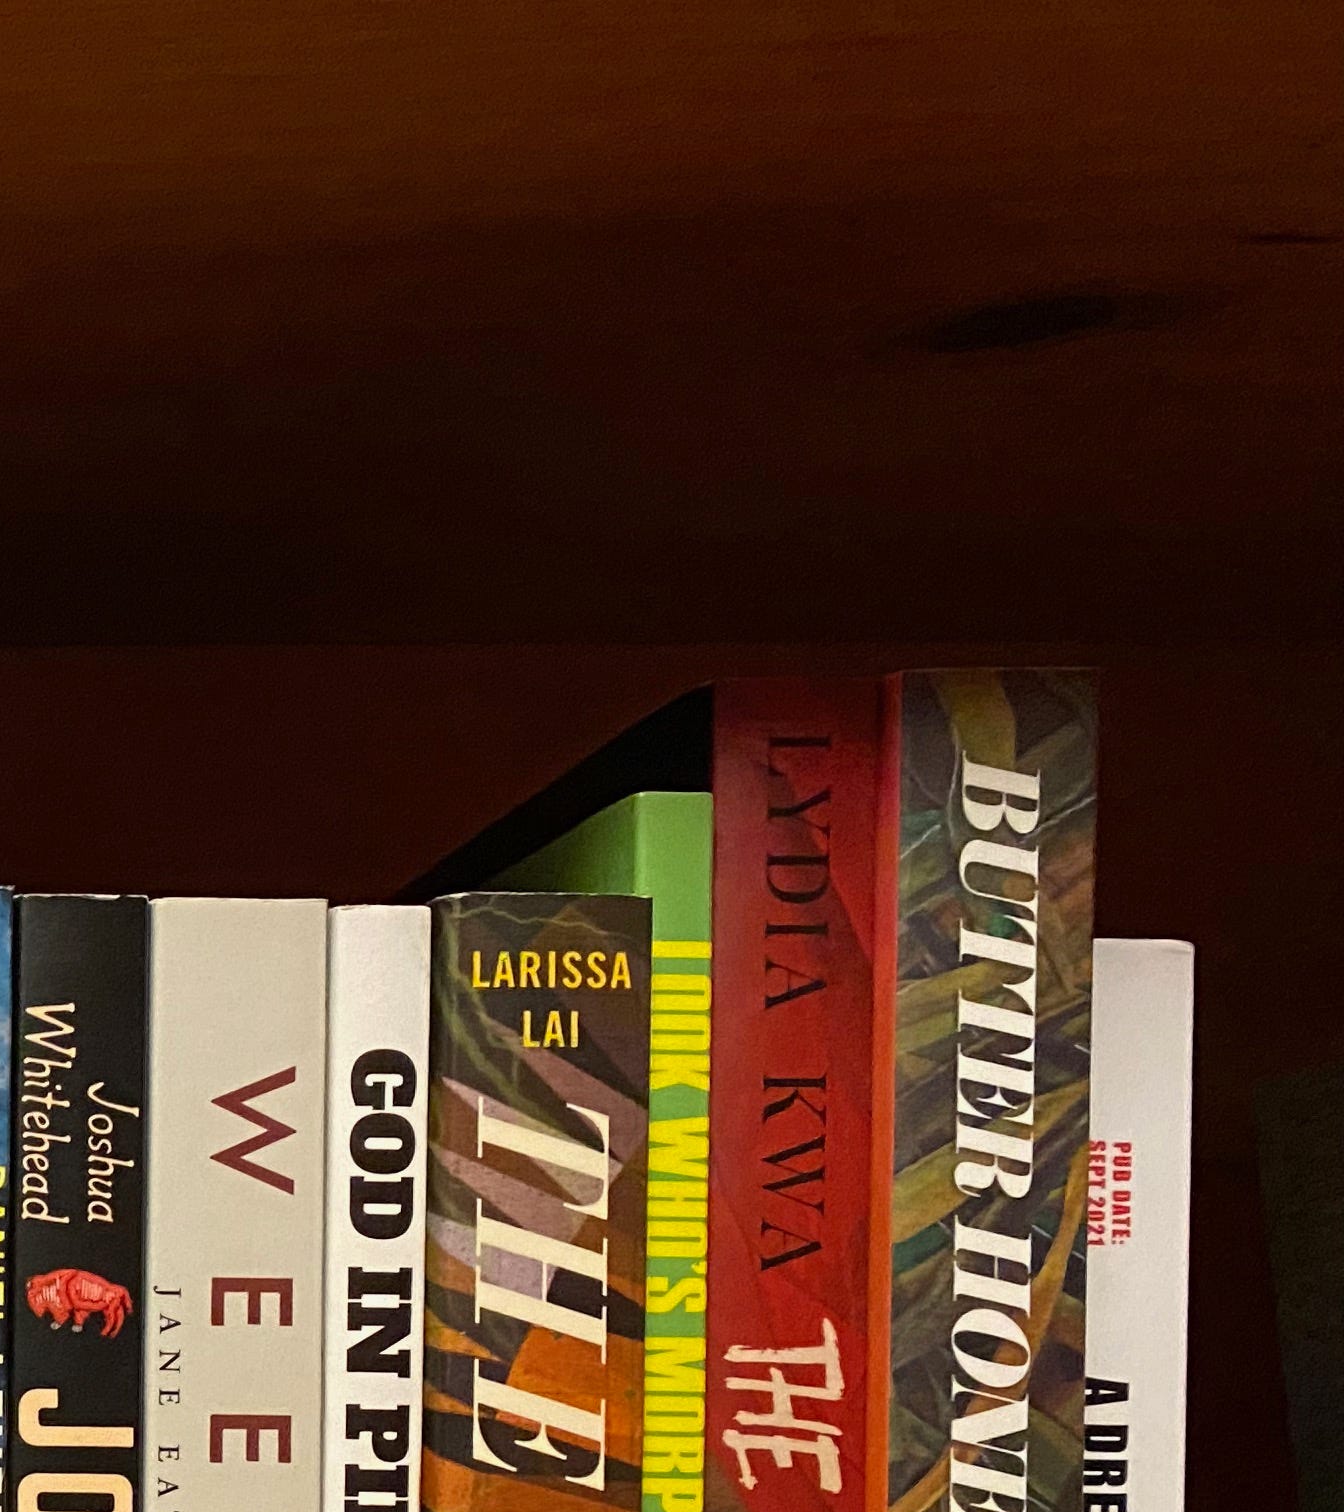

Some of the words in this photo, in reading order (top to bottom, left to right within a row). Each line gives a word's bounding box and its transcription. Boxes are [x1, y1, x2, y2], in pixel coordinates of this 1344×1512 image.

[762, 735, 832, 1011] LYDIA
[472, 950, 632, 989] LARISSA
[523, 1010, 580, 1048] LAI
[954, 756, 1039, 1200] BUTTER
[20, 1002, 74, 1222] Whitehead
[86, 1082, 138, 1222] Joshua
[348, 1050, 415, 1241] GOD
[762, 1078, 832, 1273] KWA
[154, 1286, 179, 1404] JANE
[348, 1266, 415, 1376] IN
[471, 1098, 607, 1489] THE
[722, 1321, 843, 1493] THE
